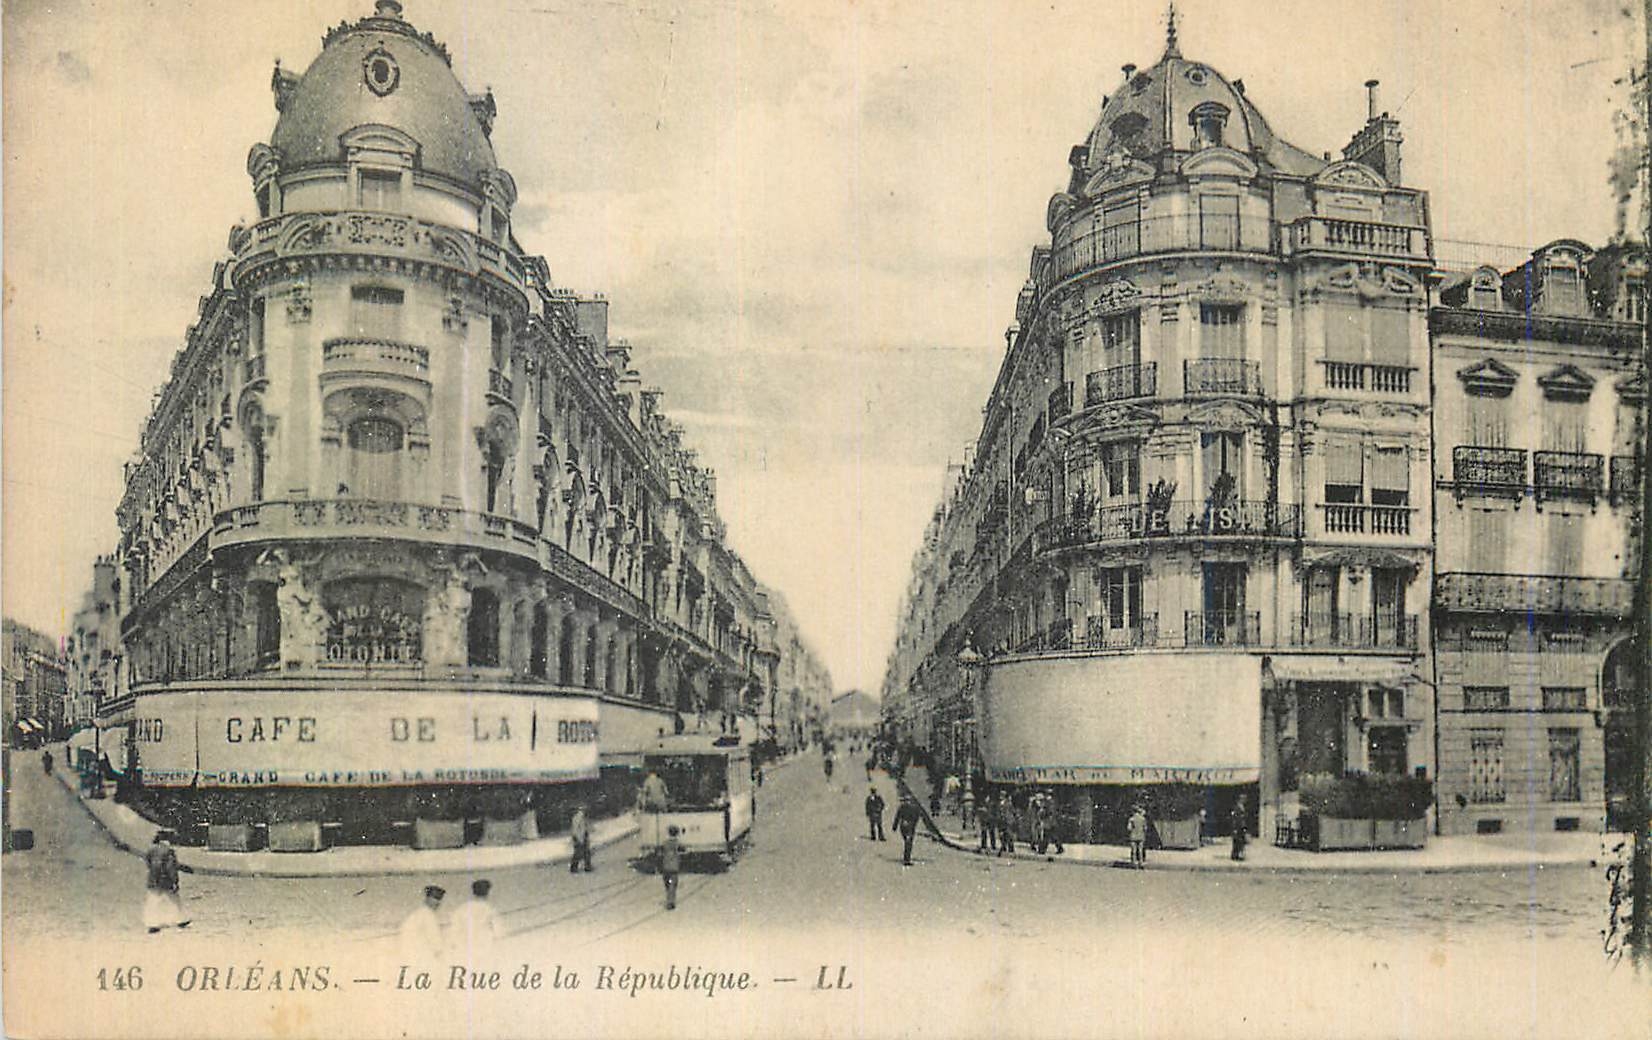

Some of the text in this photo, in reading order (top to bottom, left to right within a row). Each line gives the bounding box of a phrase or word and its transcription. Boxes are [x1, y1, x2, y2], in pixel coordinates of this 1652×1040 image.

[391, 717, 436, 742] DE
[473, 716, 513, 741] LA
[218, 771, 279, 784] GRAND
[370, 770, 390, 781] DE
[403, 769, 424, 780] LA
